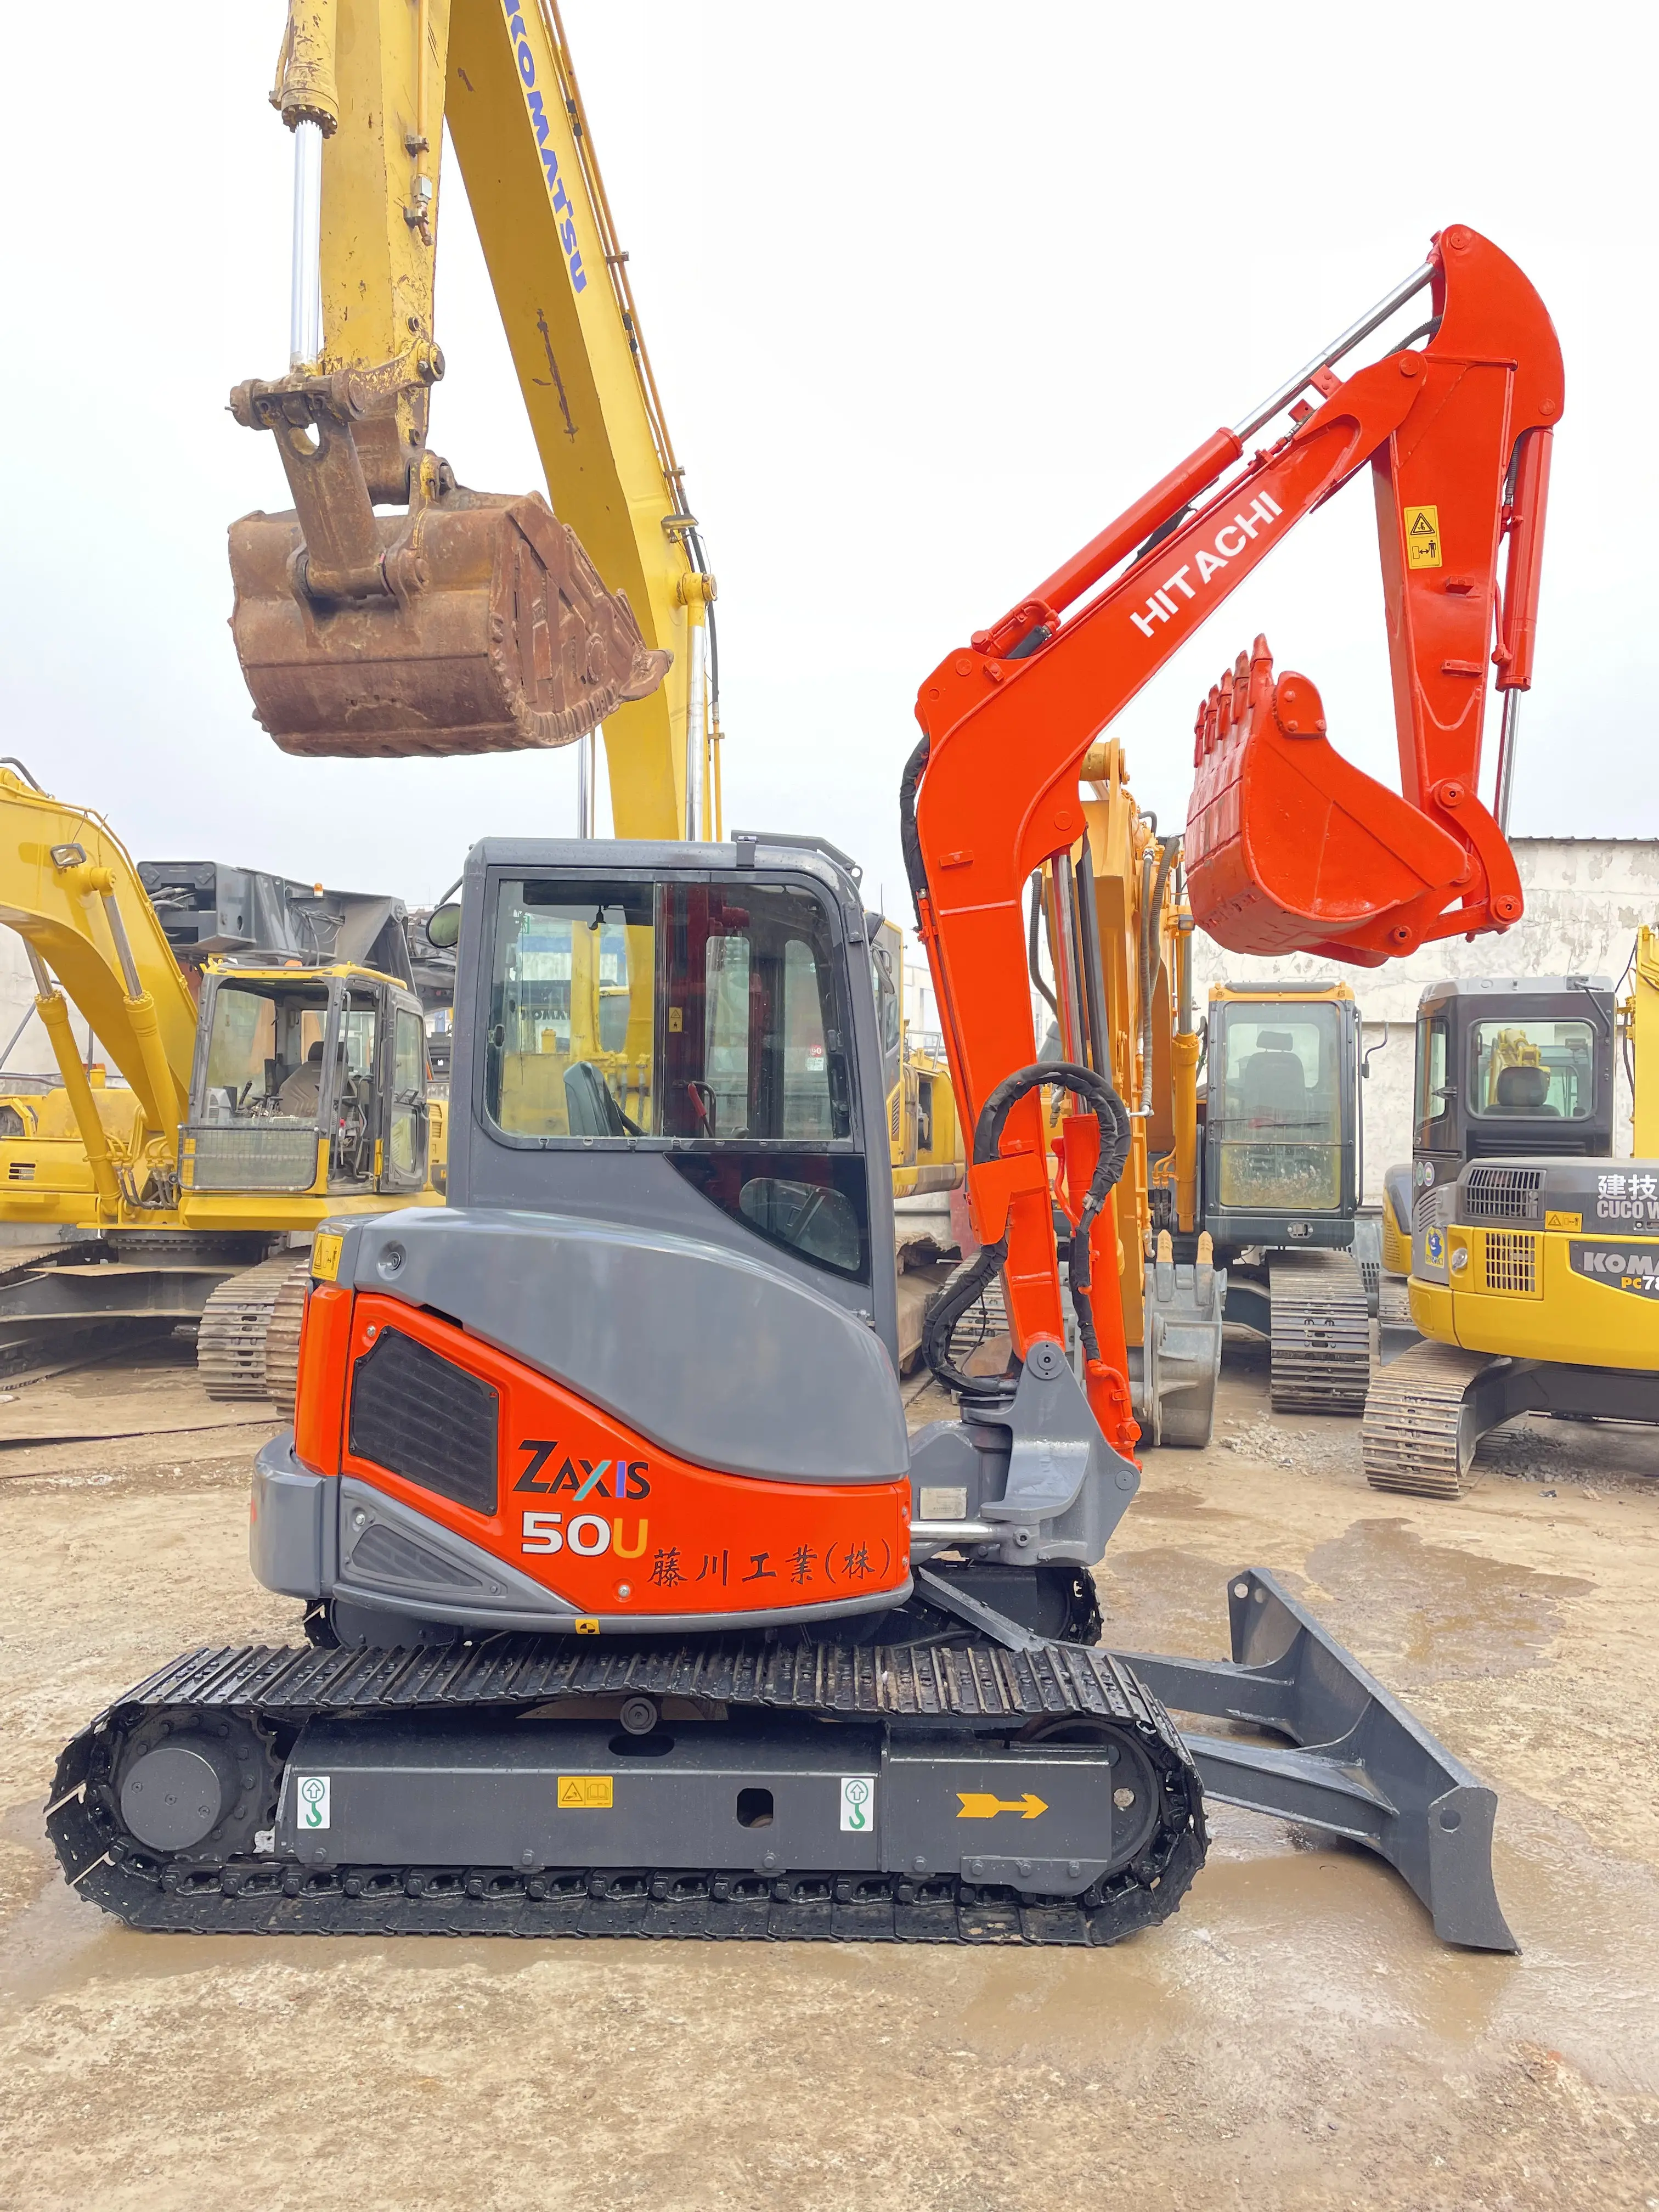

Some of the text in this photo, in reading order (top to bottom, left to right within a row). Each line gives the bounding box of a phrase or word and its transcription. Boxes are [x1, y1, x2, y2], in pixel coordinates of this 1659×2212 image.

[504, 0, 588, 294] KOMATSU
[1129, 490, 1283, 638] HITACHI
[1597, 1200, 1644, 1219] CUCO
[1598, 1174, 1658, 1201] 建技
[1583, 1252, 1659, 1276] KOM
[512, 1439, 651, 1501] ZAXIS
[521, 1510, 648, 1559] 50U
